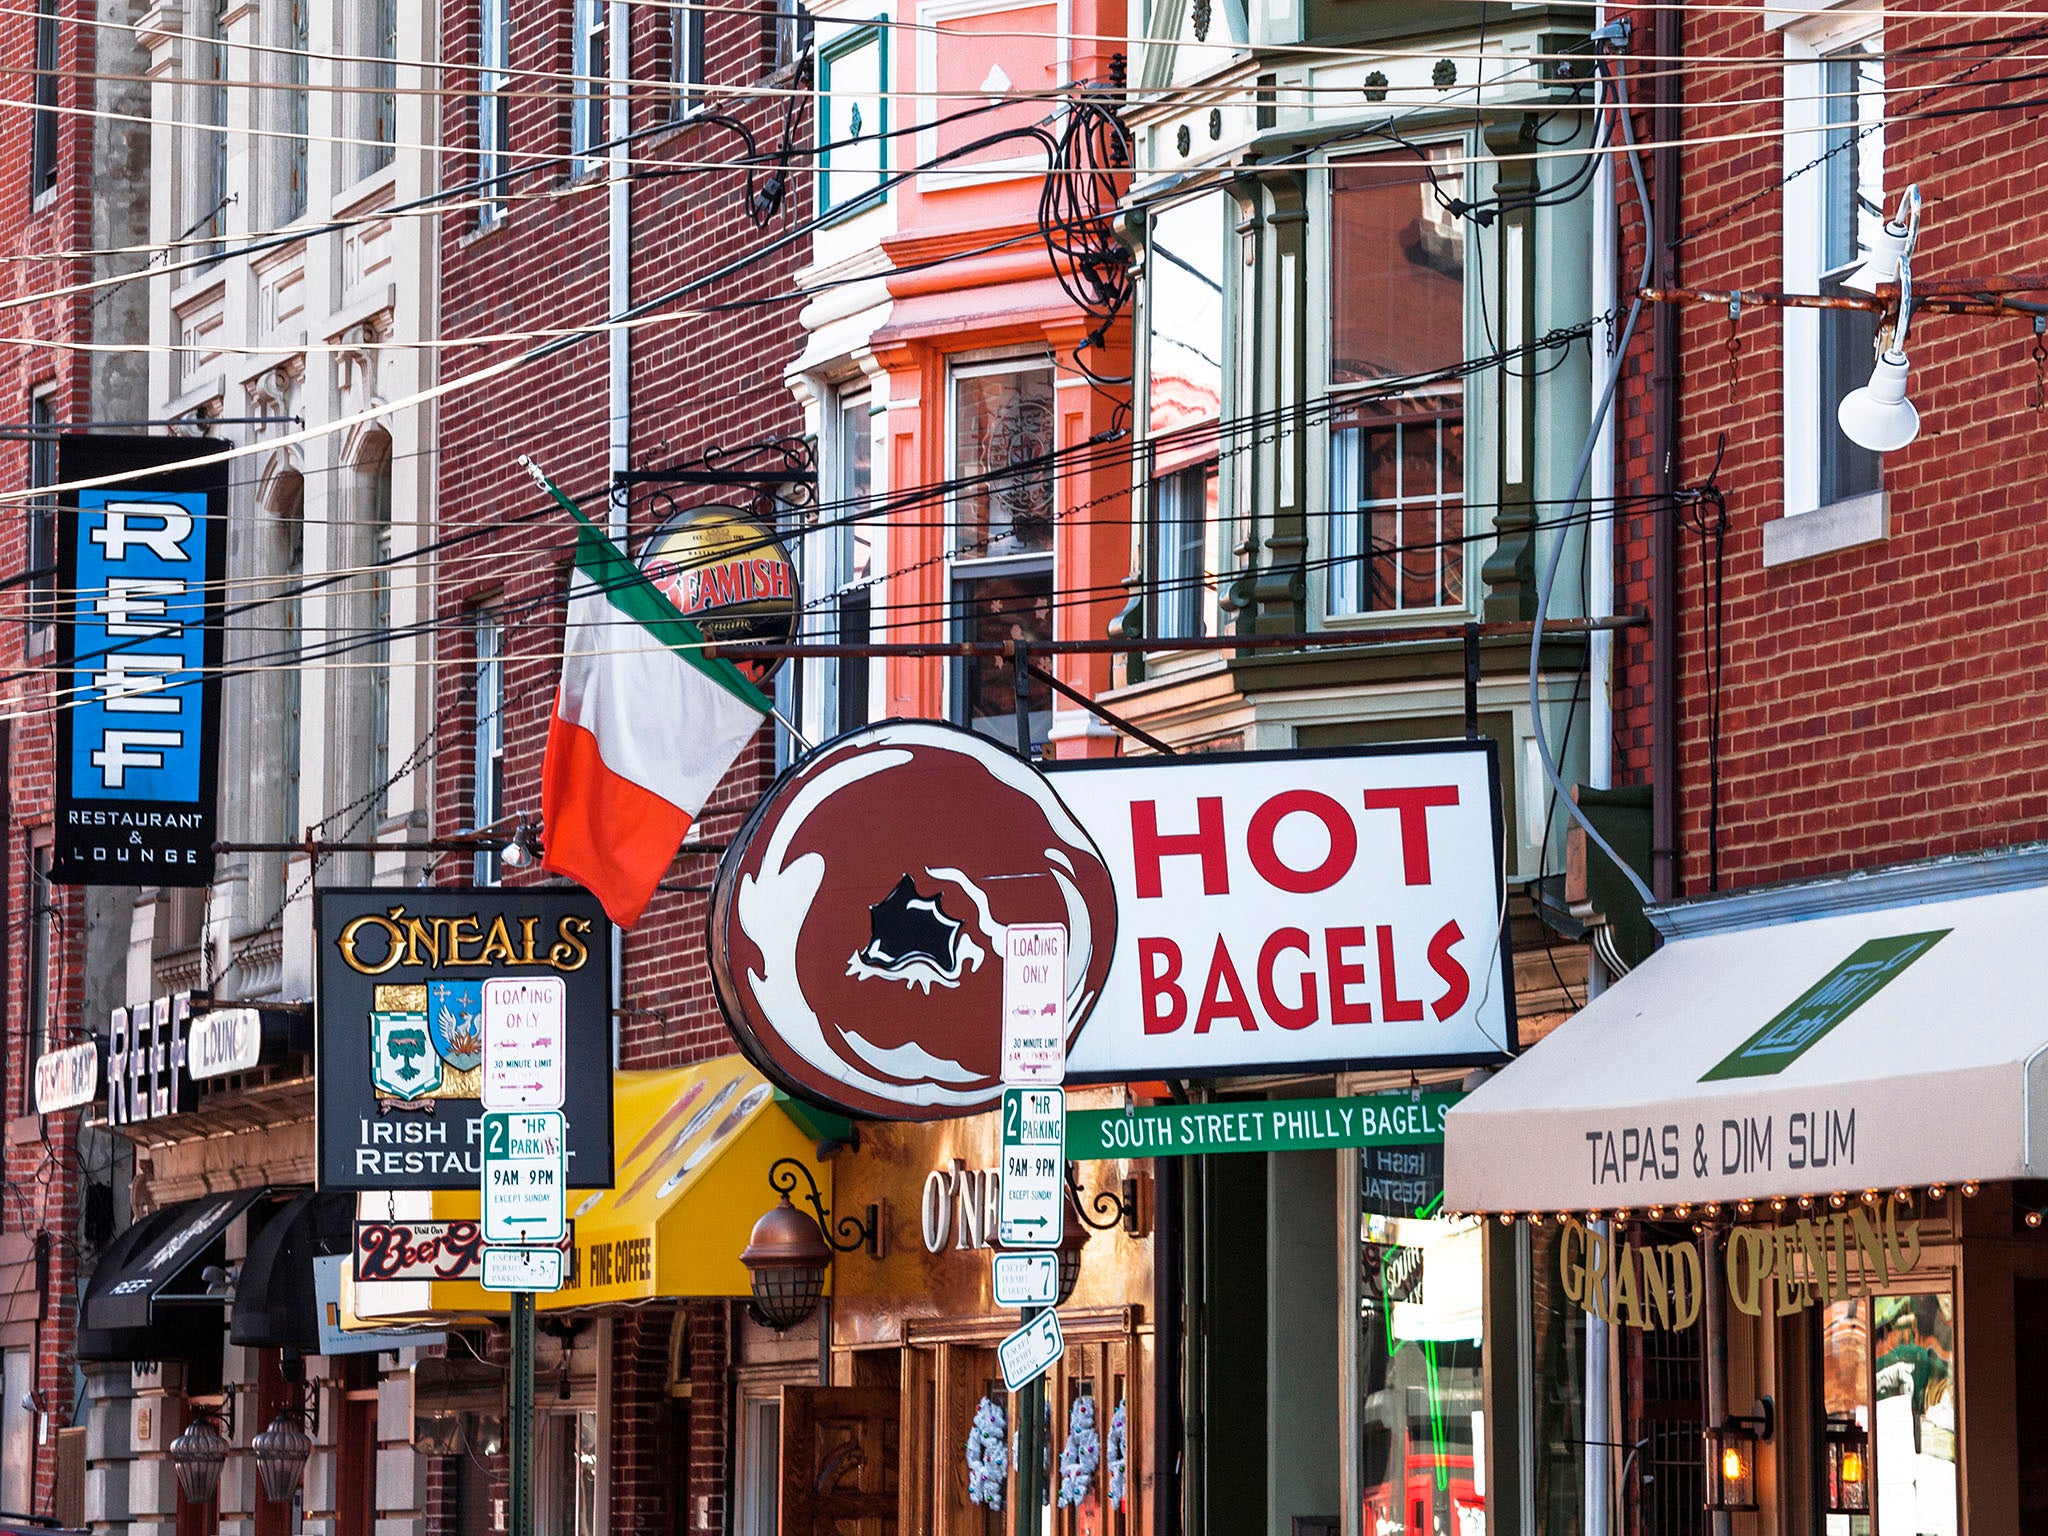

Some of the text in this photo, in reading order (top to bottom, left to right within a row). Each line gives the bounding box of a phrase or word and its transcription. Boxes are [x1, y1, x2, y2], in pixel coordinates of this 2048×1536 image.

[642, 558, 791, 615] BEAMISH
[89, 501, 196, 789] REEF
[69, 810, 203, 829] RESTAURANT
[129, 829, 143, 845] &
[74, 847, 197, 864] LOUNGE
[1130, 785, 1460, 899] HOT
[335, 904, 592, 976] O'NEALS
[1014, 937, 1058, 956] LOADING
[1022, 965, 1049, 984] ONLY
[1137, 919, 1470, 1035] BAGELS
[506, 1012, 540, 1029] ONLY
[107, 990, 191, 1126] REEF
[1013, 1038, 1058, 1048] 30 MINUTE LIMIT
[494, 1058, 552, 1069] 30 MINUTE LIMIT
[361, 1119, 447, 1145] IRISH
[1007, 1095, 1050, 1136] 2 HR
[1022, 1119, 1061, 1140] PARKING
[1101, 1102, 1445, 1149] SOUTH STREET PHILLY BAGELS
[489, 1120, 504, 1154] 2
[527, 1118, 546, 1134] HR
[1586, 1107, 1856, 1185] TAPAS & DIM SUM
[494, 1193, 551, 1203] EXCEPT SUNDAY
[922, 1158, 1000, 1252] O'NE
[1009, 1190, 1052, 1200] EXCEPT SUNDAY
[414, 1225, 429, 1235] Visit
[360, 1224, 451, 1280] Beer
[590, 1243, 612, 1288] FINE
[615, 1237, 651, 1284] COFFEE
[1727, 1194, 1921, 1317] OPENING
[1041, 1261, 1051, 1296] 7
[1560, 1218, 1701, 1331] GRAND
[1042, 1319, 1056, 1355] 5
